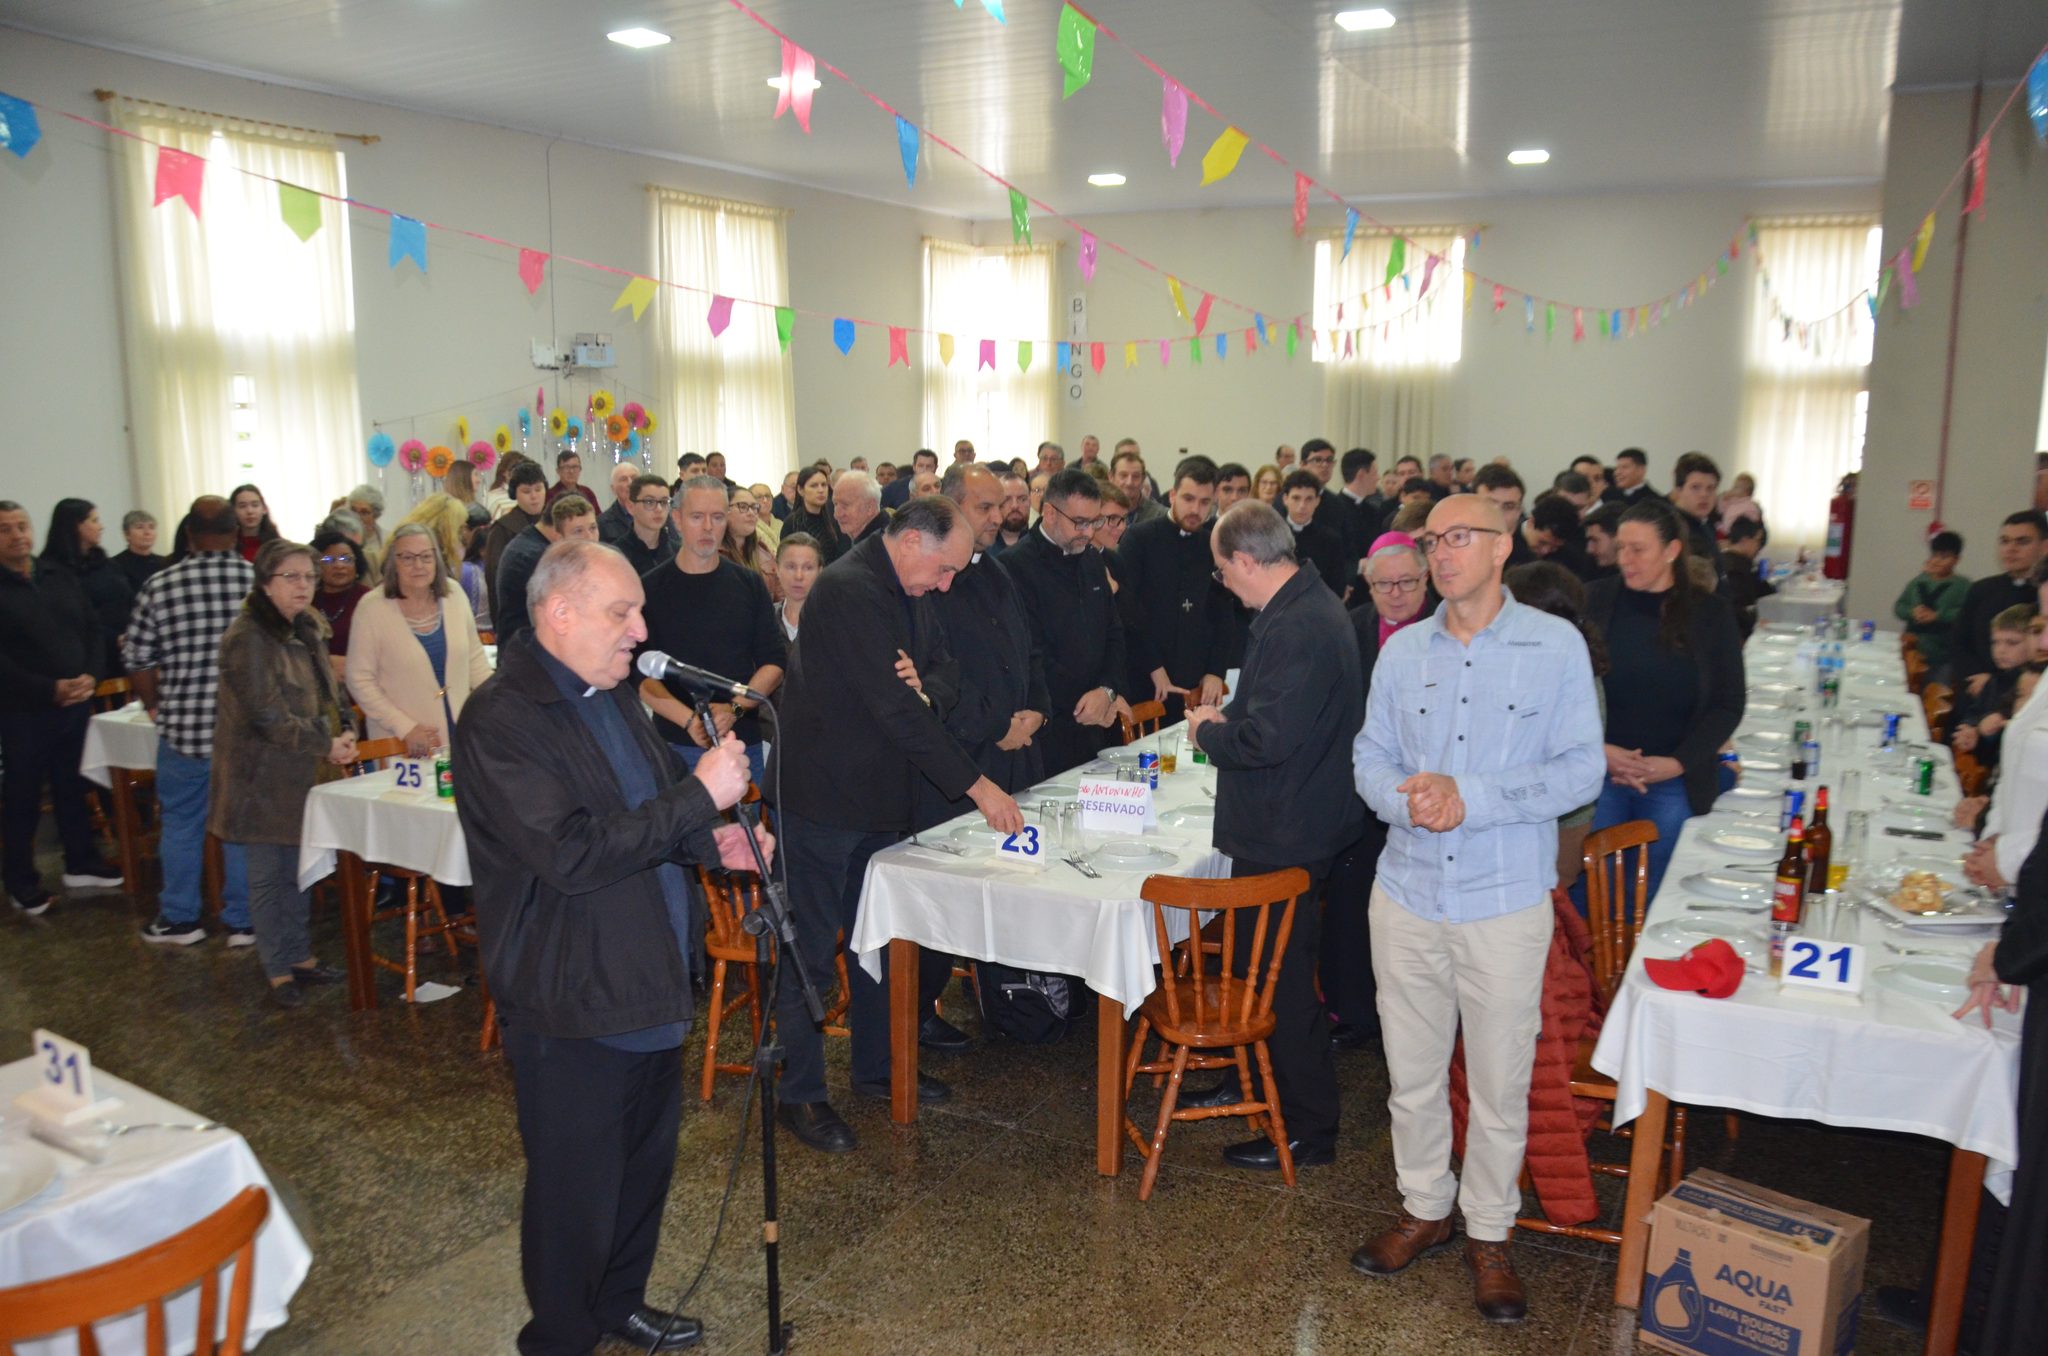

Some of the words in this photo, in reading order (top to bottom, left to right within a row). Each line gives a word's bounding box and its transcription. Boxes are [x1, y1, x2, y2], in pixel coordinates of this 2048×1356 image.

[1070, 299, 1083, 399] BINGO
[395, 762, 421, 788] 25
[1079, 799, 1146, 816] RESERVADO
[1001, 826, 1040, 855] 23
[1788, 941, 1851, 983] 21
[42, 1040, 83, 1095] 31
[1715, 1264, 1793, 1306] AQUA
[1759, 1300, 1787, 1315] FAST
